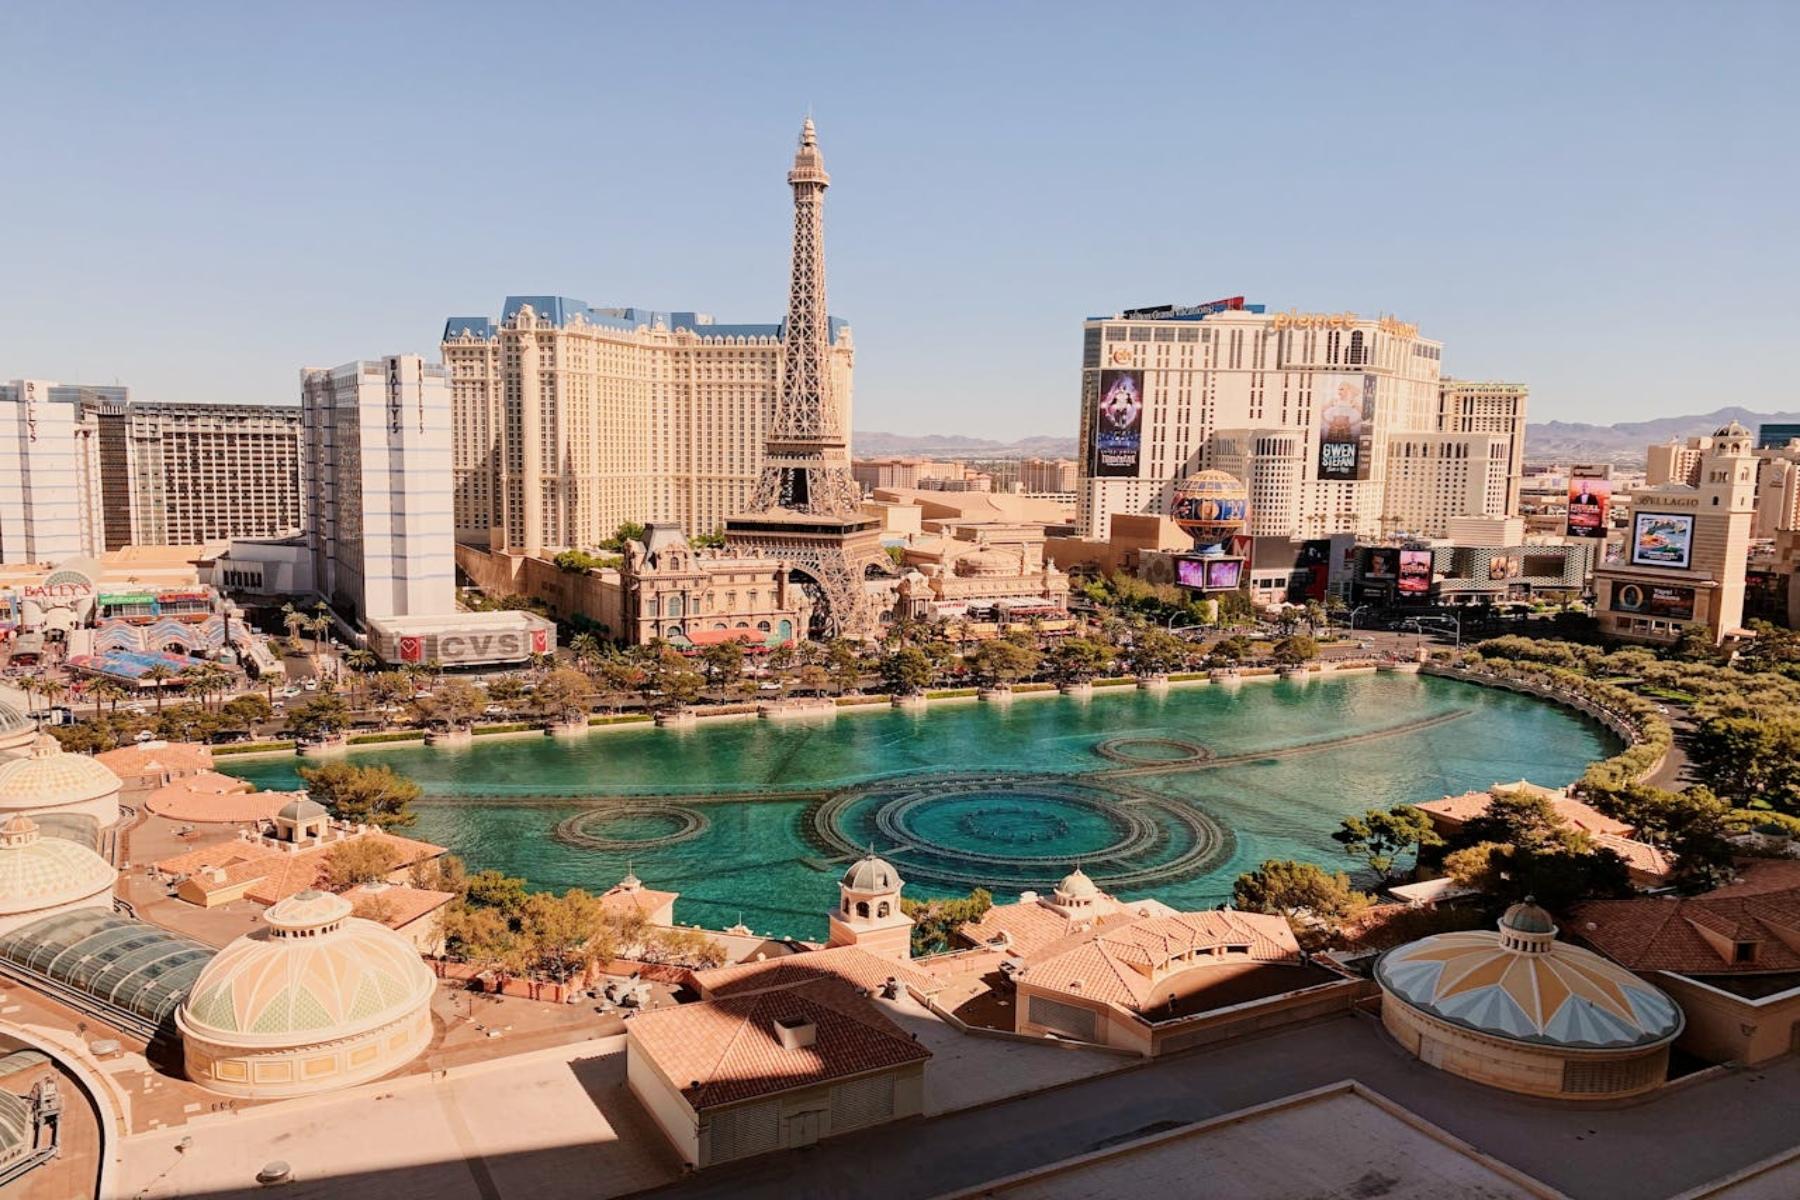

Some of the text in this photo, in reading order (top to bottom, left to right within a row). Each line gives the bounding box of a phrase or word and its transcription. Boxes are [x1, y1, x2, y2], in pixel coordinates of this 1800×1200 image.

[1322, 443, 1356, 457] GWEN
[1321, 455, 1355, 467] STEFANI
[1635, 495, 1699, 507] BELLAGIO
[24, 583, 92, 598] BALLY'S
[440, 634, 519, 658] CVS
